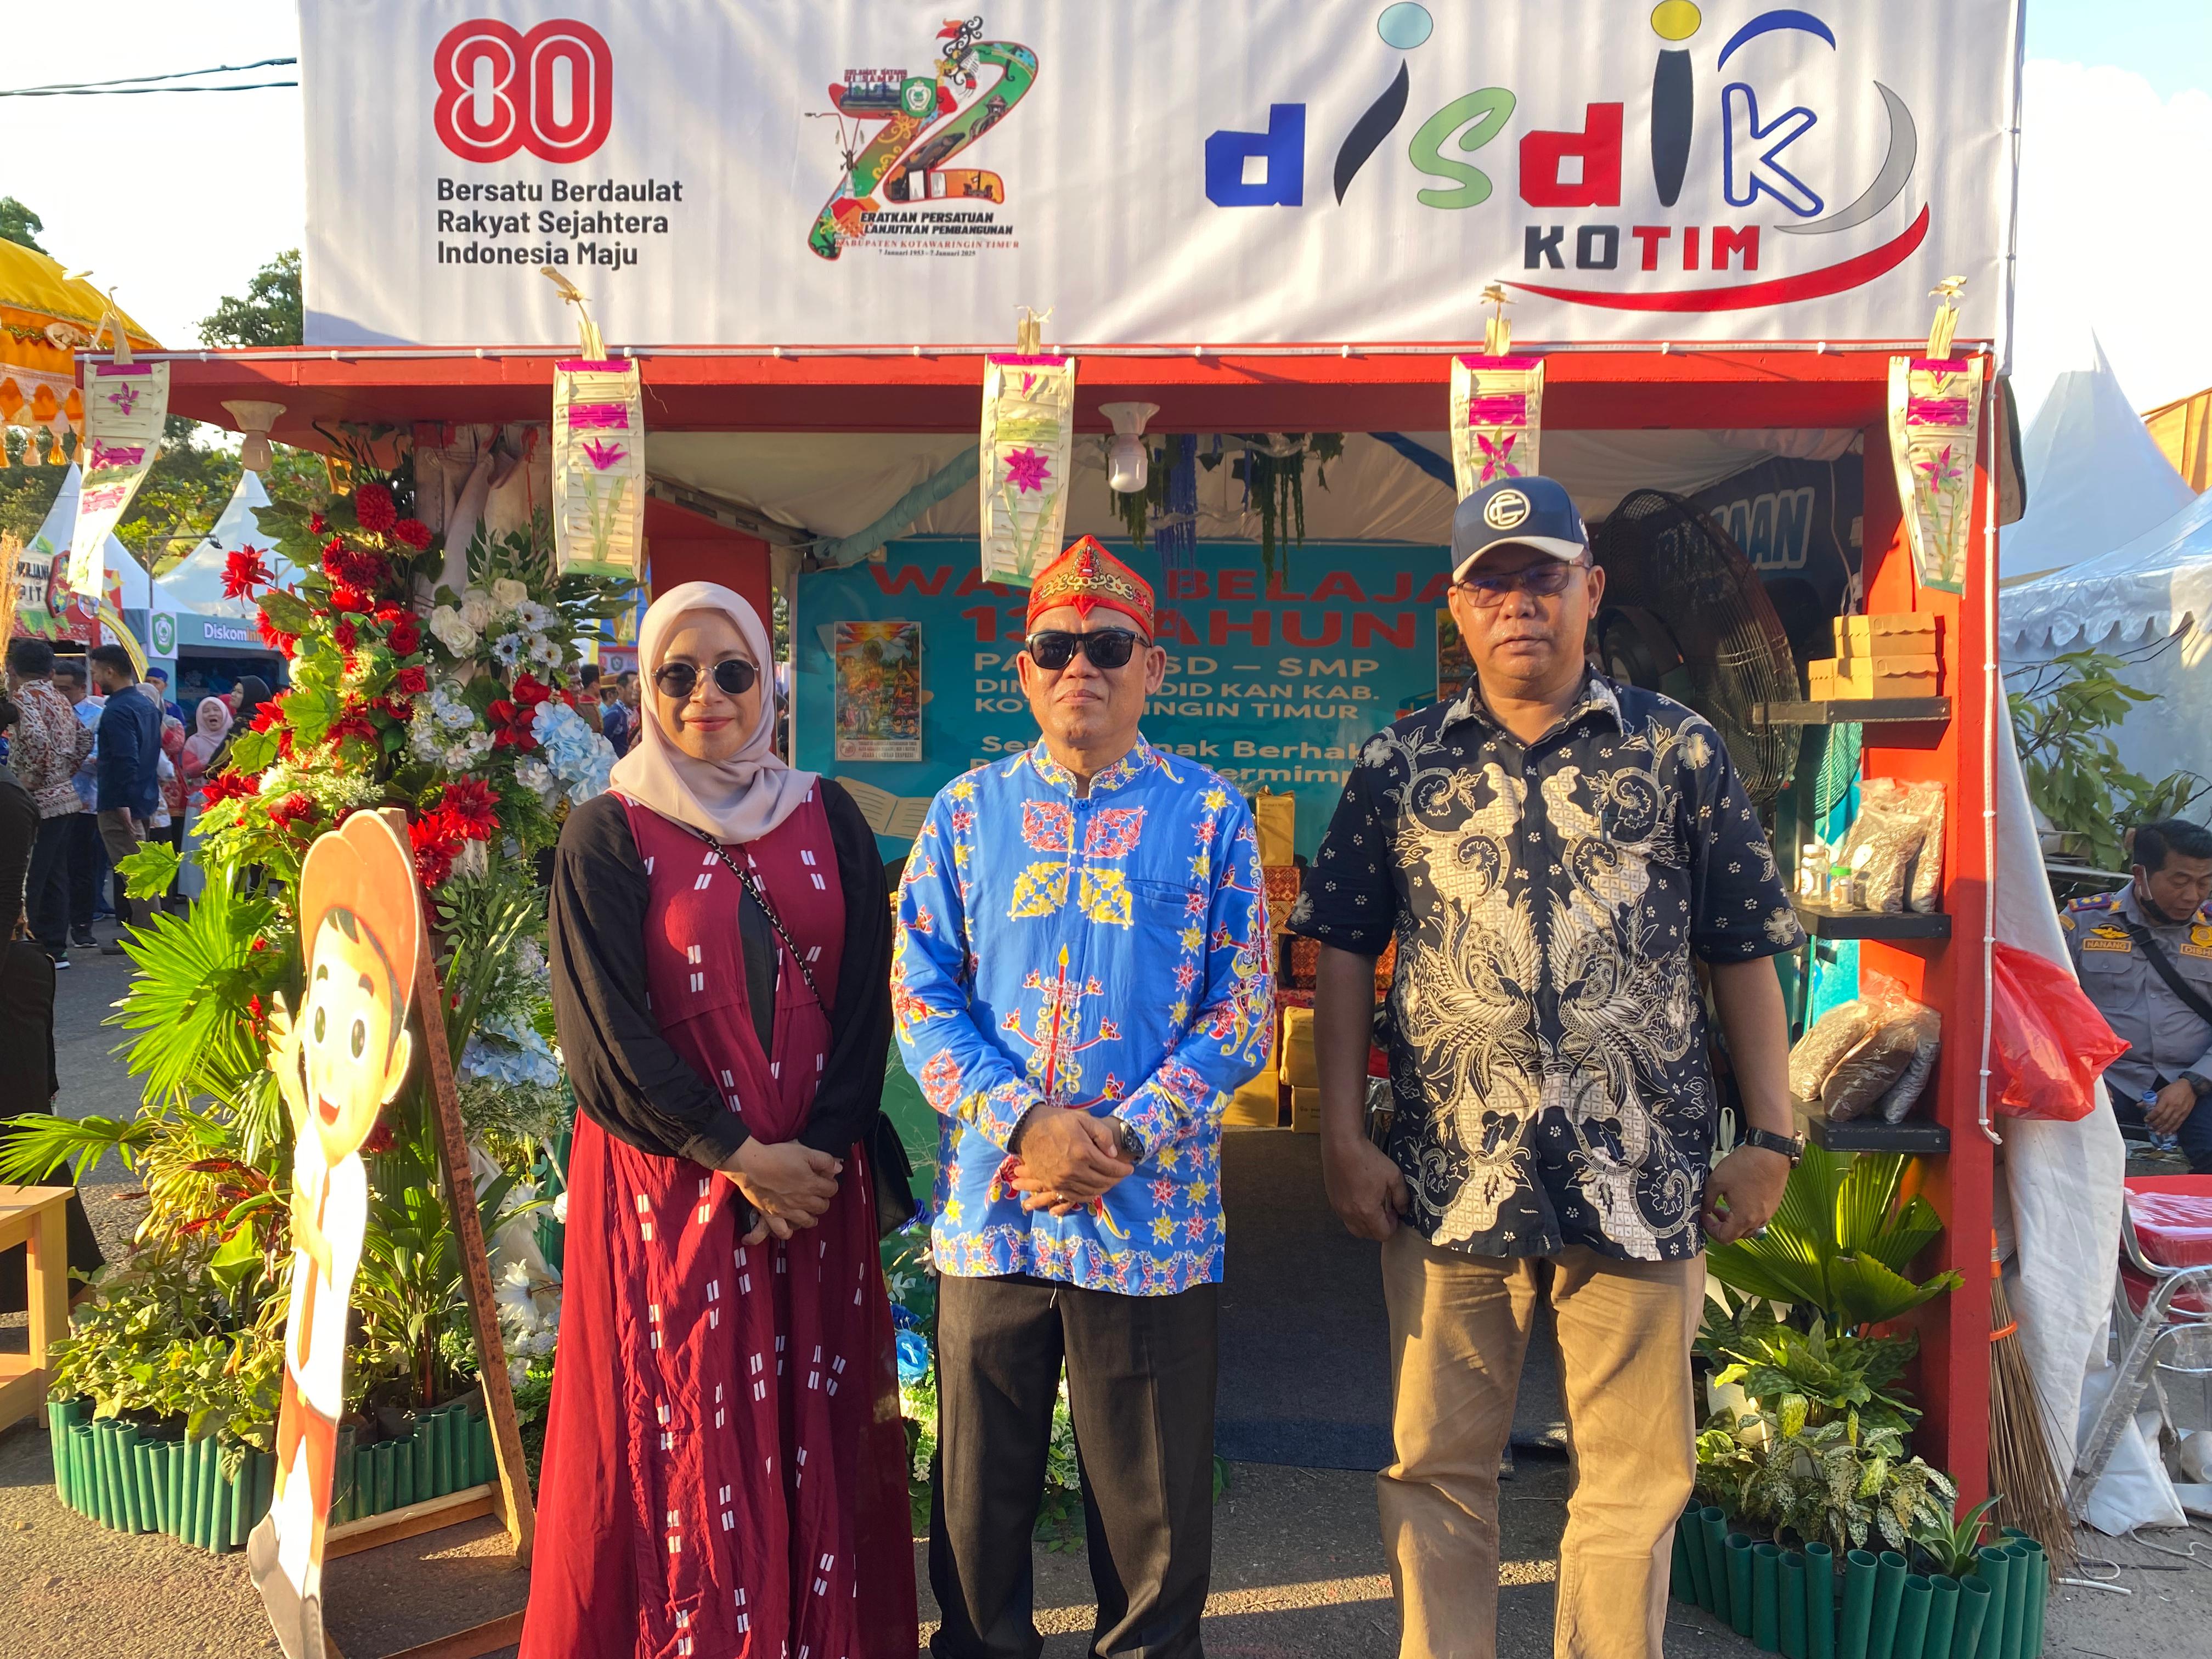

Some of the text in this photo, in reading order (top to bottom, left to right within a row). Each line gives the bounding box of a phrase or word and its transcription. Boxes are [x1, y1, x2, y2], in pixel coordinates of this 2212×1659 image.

[433, 18, 613, 163] 80
[1205, 0, 1825, 217] disdik
[438, 178, 682, 202] Bersatu Berdaulat
[438, 210, 668, 240] Rakyat Sejahtera
[860, 212, 994, 223] ERATKAN PERSATUAN
[864, 224, 1013, 235] LANJUTKAN PEMBANGUNAN
[836, 239, 1019, 249] KABUPATEN KOTAWARINGIN TIMUR
[1523, 225, 1760, 271] KOTIM
[438, 241, 637, 271] Indonesia Maju
[1277, 657, 1380, 678] SMP
[1303, 685, 1380, 700] KAB.
[1251, 703, 1359, 720] TIMUR
[2087, 940, 2127, 949] NANANG
